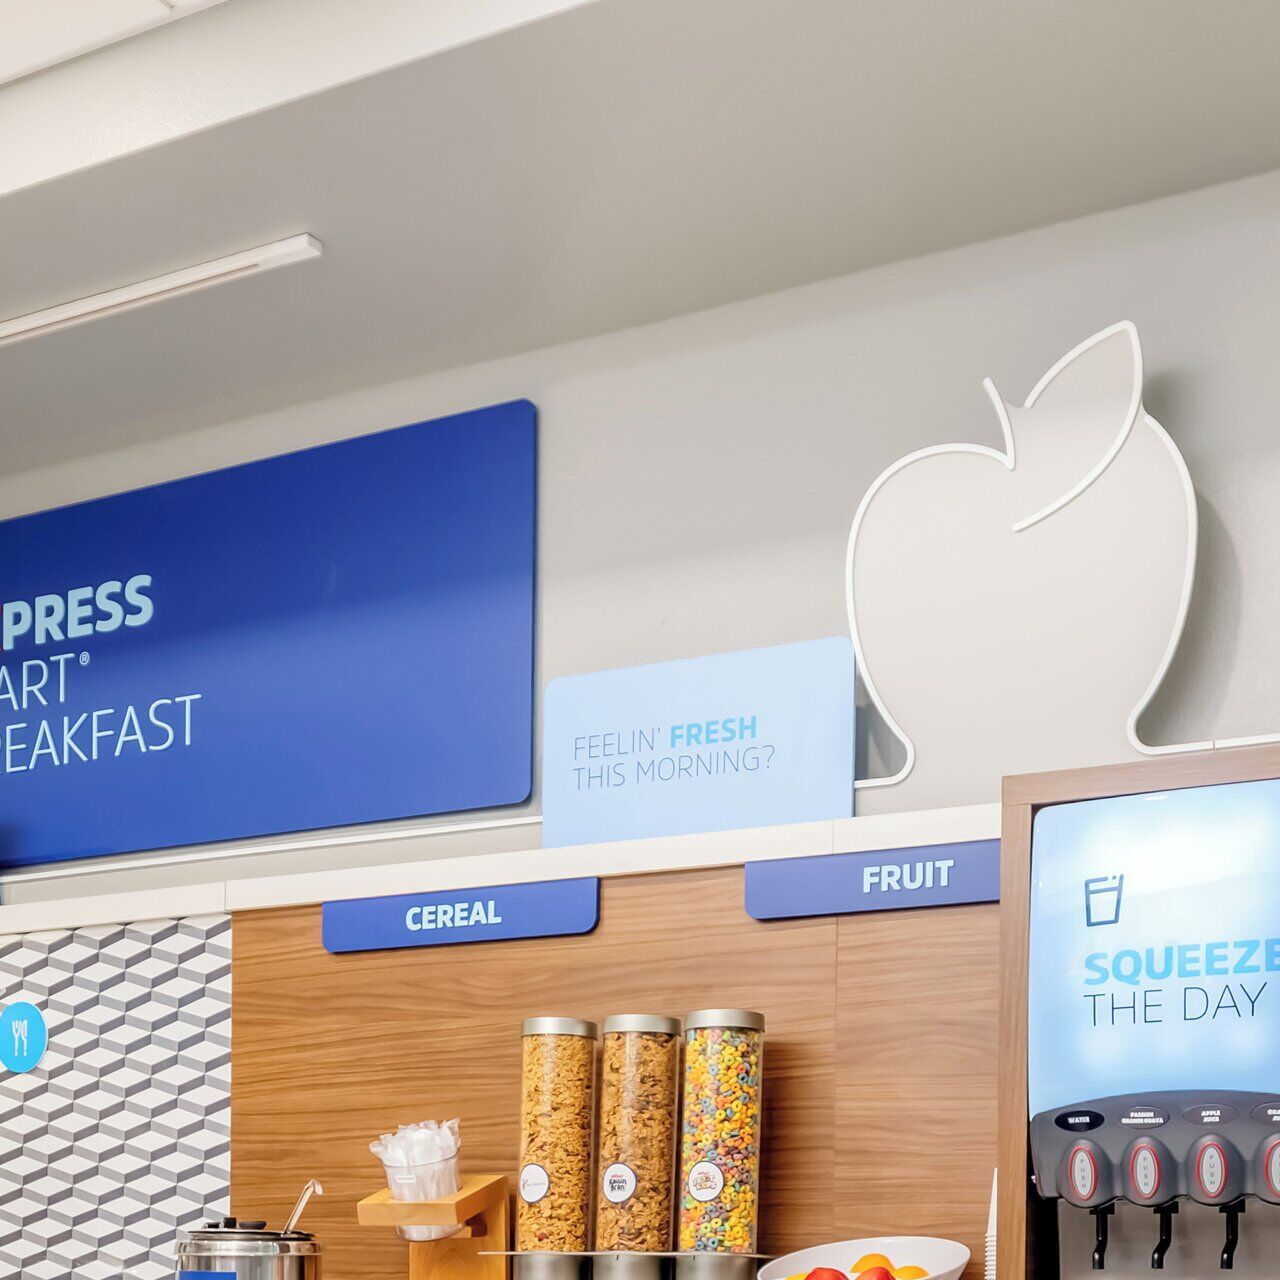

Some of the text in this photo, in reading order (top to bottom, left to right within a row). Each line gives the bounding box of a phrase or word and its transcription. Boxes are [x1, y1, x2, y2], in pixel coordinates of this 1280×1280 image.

[573, 715, 757, 760] FEELIN' FRESH
[573, 745, 776, 790] THIS MORNING?
[863, 860, 955, 893] FRUIT
[405, 900, 502, 931] CEREAL
[1083, 982, 1268, 1026] THE DAY
[1067, 1116, 1090, 1124] WATER
